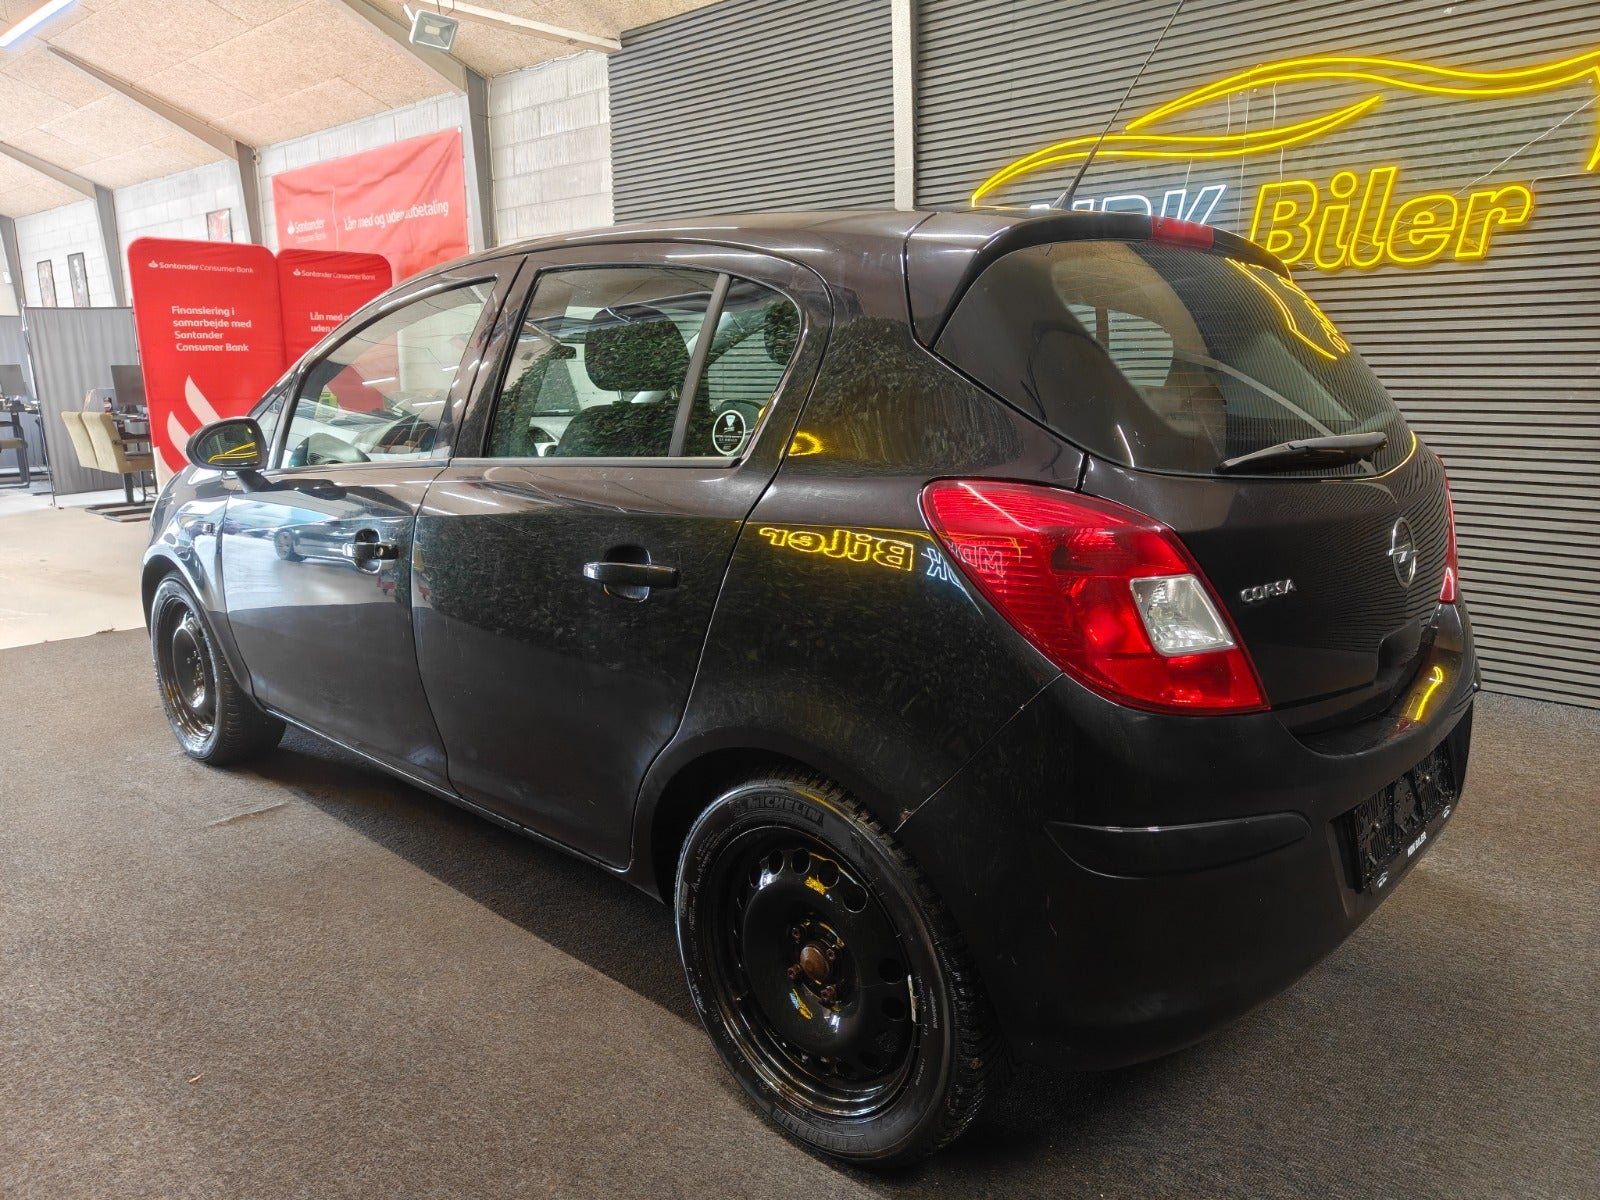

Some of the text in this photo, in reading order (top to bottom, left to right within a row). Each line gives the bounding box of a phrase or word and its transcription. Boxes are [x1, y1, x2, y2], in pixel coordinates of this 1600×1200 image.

[344, 217, 357, 231] Lån
[357, 215, 373, 227] med
[374, 214, 385, 228] og
[1249, 166, 1532, 269] Biler
[295, 218, 326, 234] Santander
[159, 261, 254, 274] Santander Consumer Bank
[301, 269, 332, 279] Santander
[171, 305, 235, 318] Finansiering i
[309, 311, 325, 321] Lån
[325, 312, 343, 321] med
[172, 318, 252, 330] samarbejde med
[310, 324, 331, 333] uden
[174, 330, 224, 340] Santander
[176, 342, 249, 352] Consumer Bank
[1240, 579, 1298, 602] CORSA
[747, 795, 822, 822] MICHELIN
